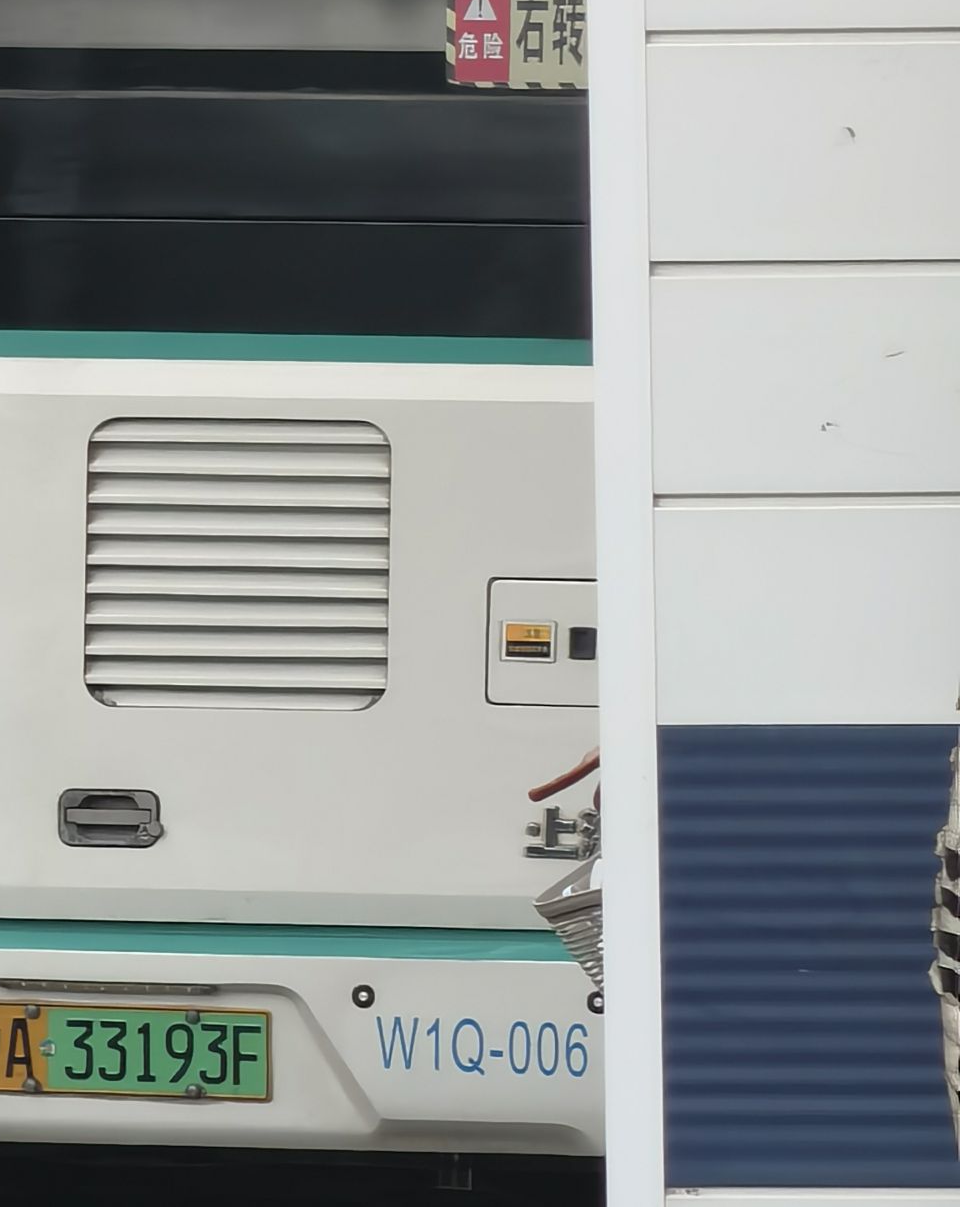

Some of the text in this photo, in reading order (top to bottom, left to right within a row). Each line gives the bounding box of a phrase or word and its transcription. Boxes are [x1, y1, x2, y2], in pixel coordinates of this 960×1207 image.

[458, 32, 504, 60] 危险
[64, 1018, 262, 1086] 33193F
[375, 1015, 589, 1078] W1Q-006
